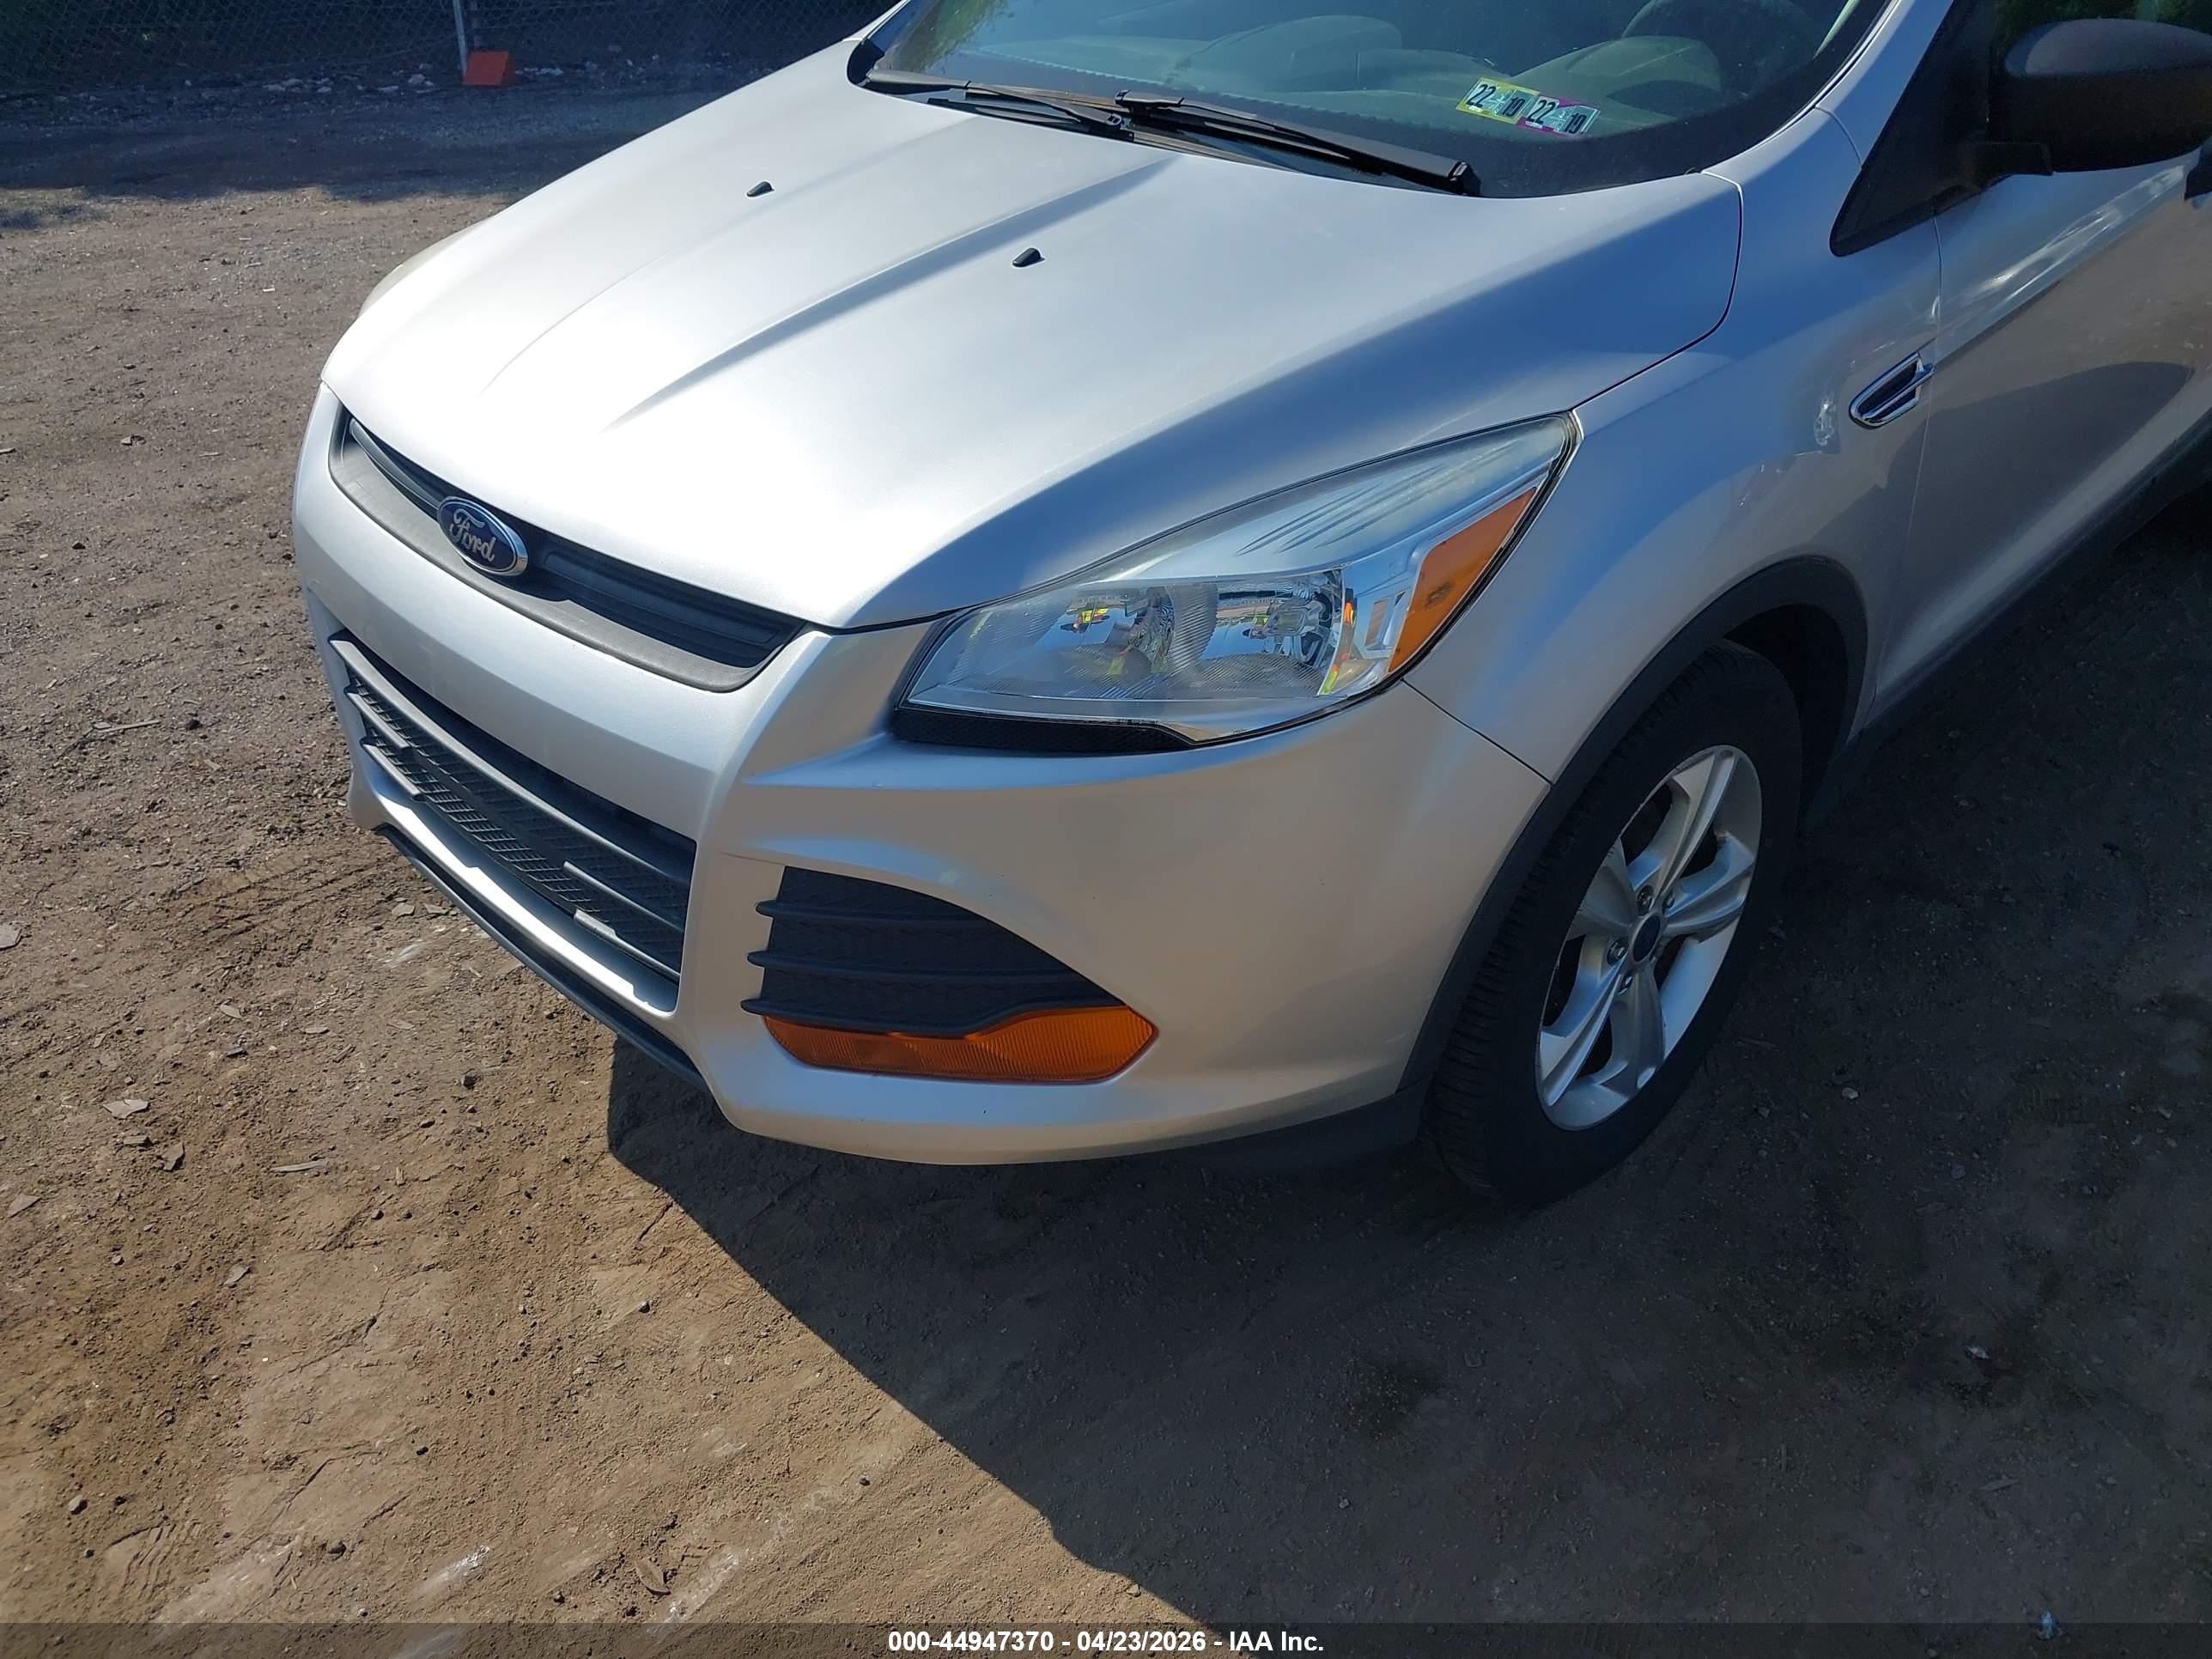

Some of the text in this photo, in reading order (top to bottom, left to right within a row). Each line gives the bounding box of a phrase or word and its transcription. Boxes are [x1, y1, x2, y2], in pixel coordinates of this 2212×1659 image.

[1466, 83, 1497, 108] 22
[1526, 99, 1557, 125] 22
[449, 507, 496, 562] Ford
